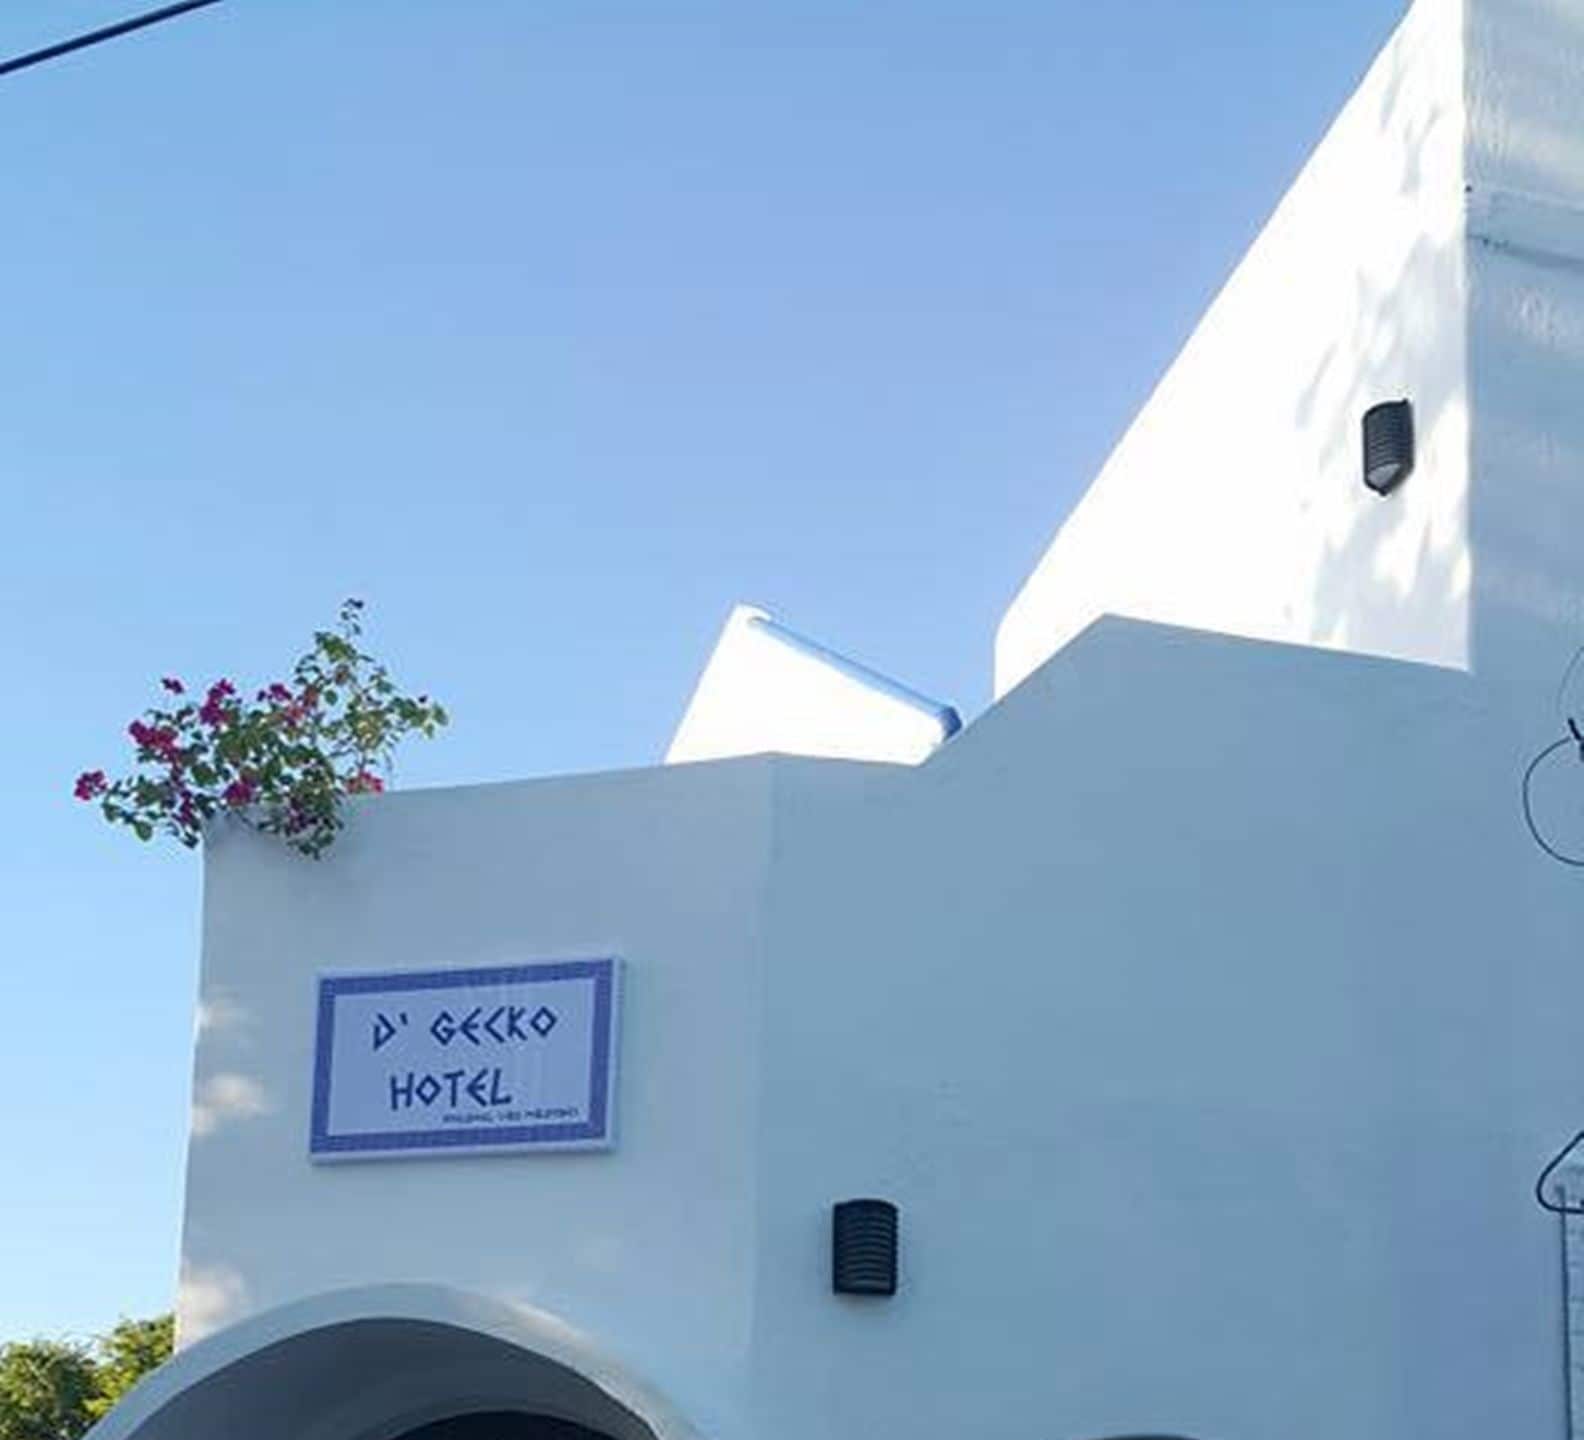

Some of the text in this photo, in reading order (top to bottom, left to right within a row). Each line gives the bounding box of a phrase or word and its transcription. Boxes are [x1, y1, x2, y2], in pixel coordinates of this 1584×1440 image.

[373, 1005, 558, 1051] D' GECKO
[389, 1067, 512, 1111] HOTEL
